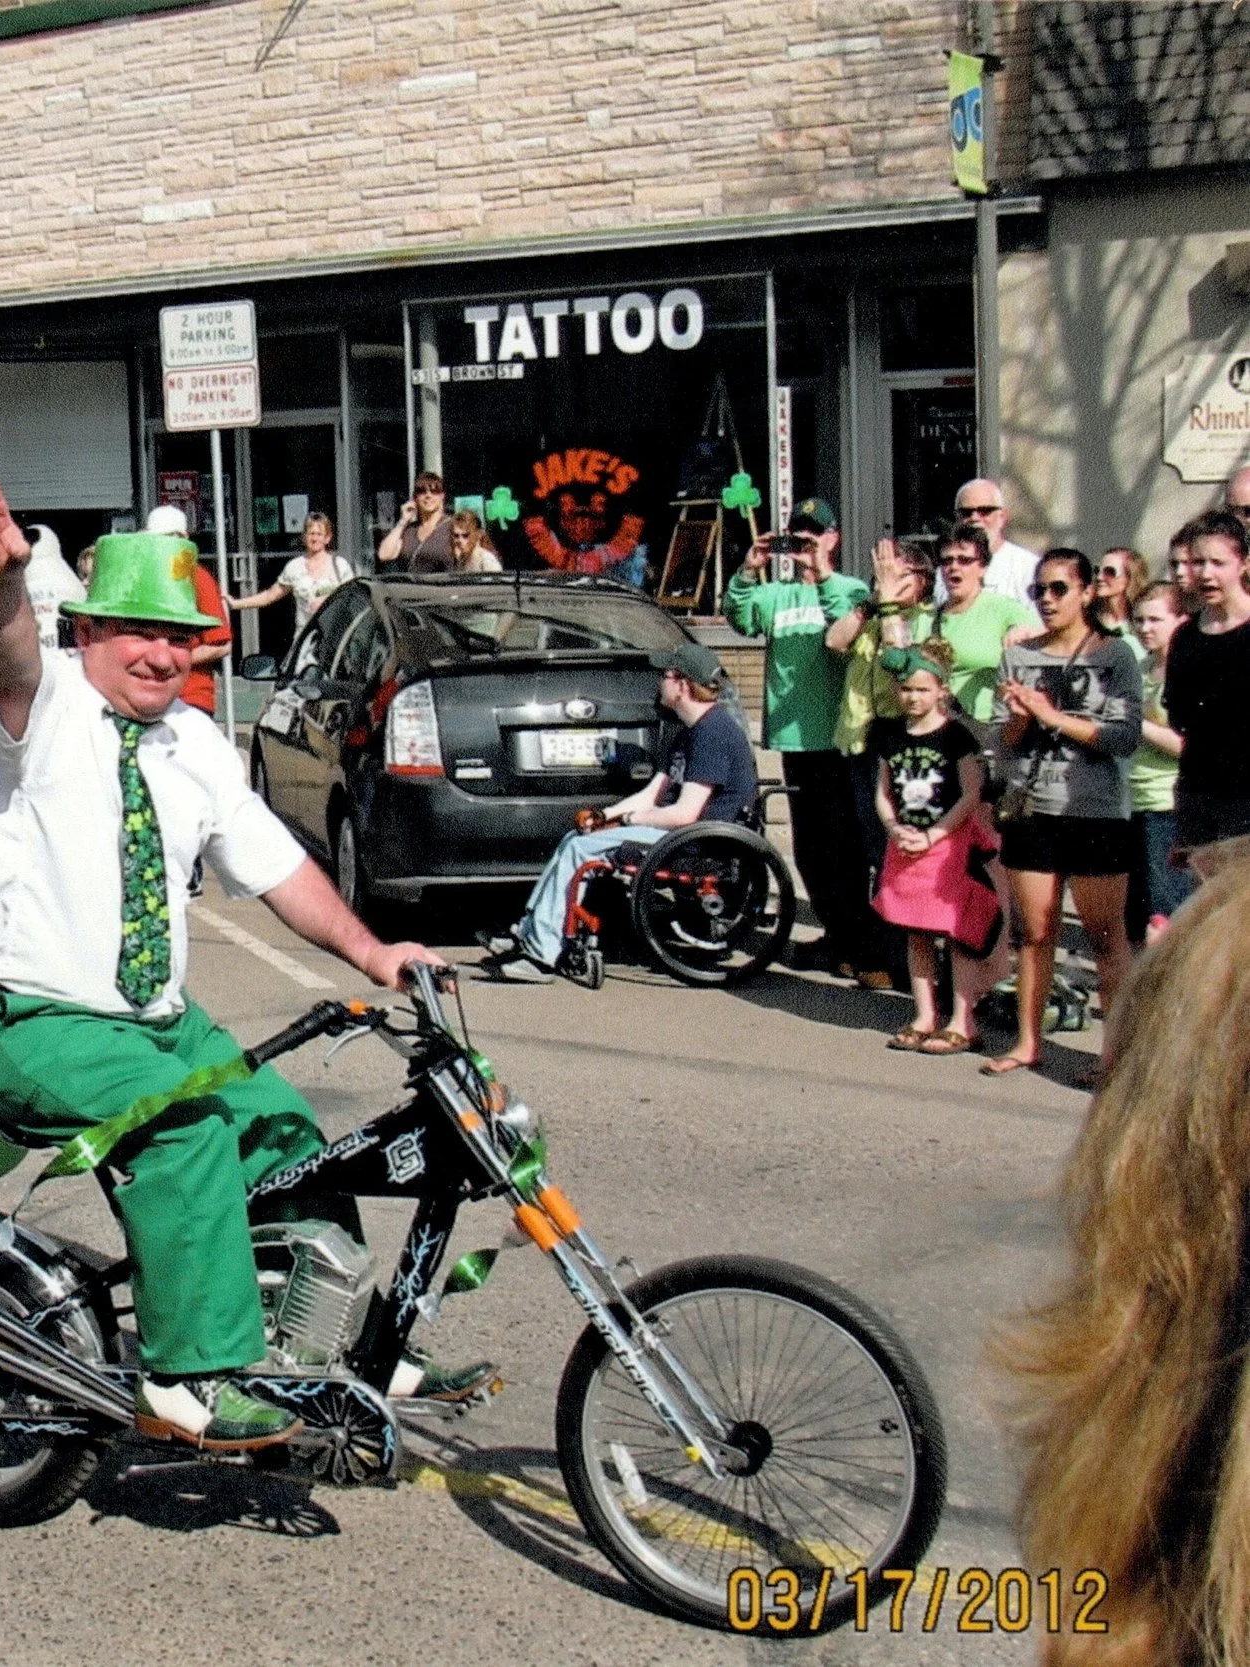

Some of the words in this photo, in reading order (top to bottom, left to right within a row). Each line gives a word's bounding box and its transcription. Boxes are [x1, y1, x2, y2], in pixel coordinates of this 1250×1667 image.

[181, 314, 190, 328] 2
[197, 310, 232, 325] HOUR
[464, 288, 703, 363] TATTOO
[180, 326, 236, 342] PARKING
[168, 377, 184, 390] NO
[190, 371, 253, 389] OVERNIGHT
[187, 388, 237, 405] PARKING
[777, 390, 789, 470] JAKES
[533, 449, 639, 498] JAKE'S
